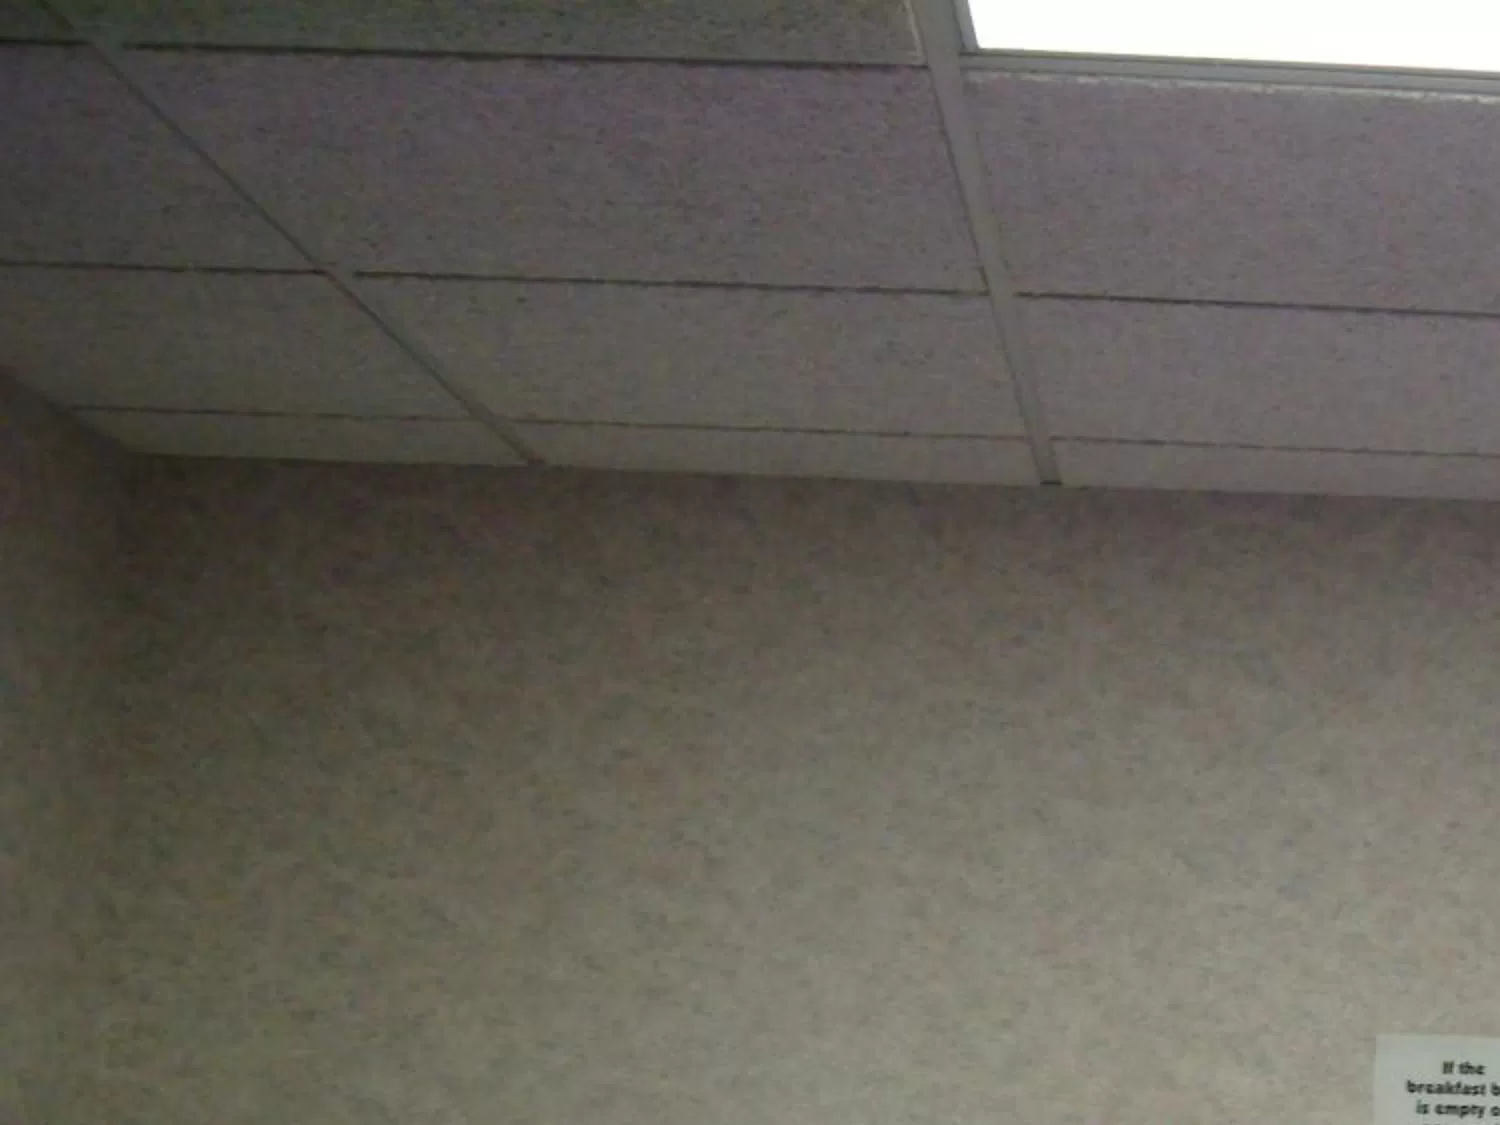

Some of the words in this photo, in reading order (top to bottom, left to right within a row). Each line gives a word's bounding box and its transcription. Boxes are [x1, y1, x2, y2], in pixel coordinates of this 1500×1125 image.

[1442, 1061, 1455, 1075] If
[1459, 1062, 1486, 1075] the
[1406, 1080, 1486, 1096] breakfast
[1416, 1100, 1429, 1115] is
[1435, 1104, 1485, 1118] empty
